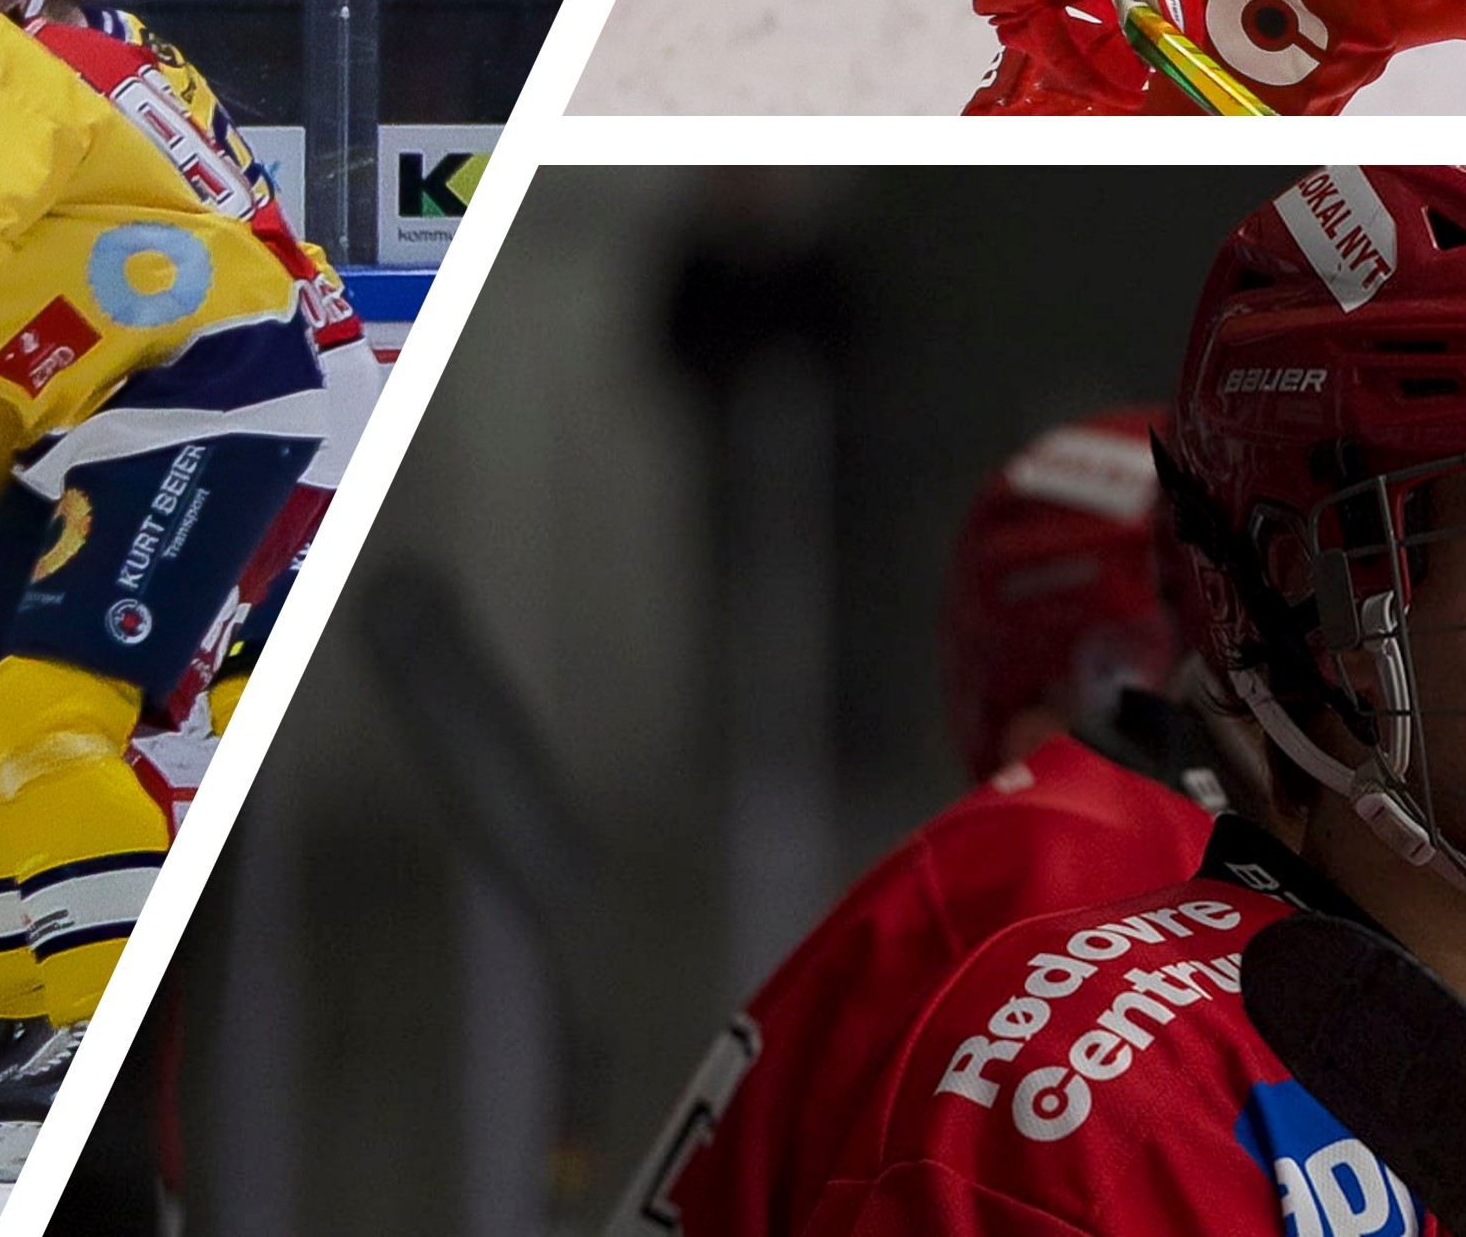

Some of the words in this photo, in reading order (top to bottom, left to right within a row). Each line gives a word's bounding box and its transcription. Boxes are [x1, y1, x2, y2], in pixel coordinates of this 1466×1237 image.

[1336, 225, 1392, 291] NYT
[115, 514, 166, 590] KURT
[150, 443, 208, 518] BEIER
[935, 900, 1241, 1109] Rødovre
